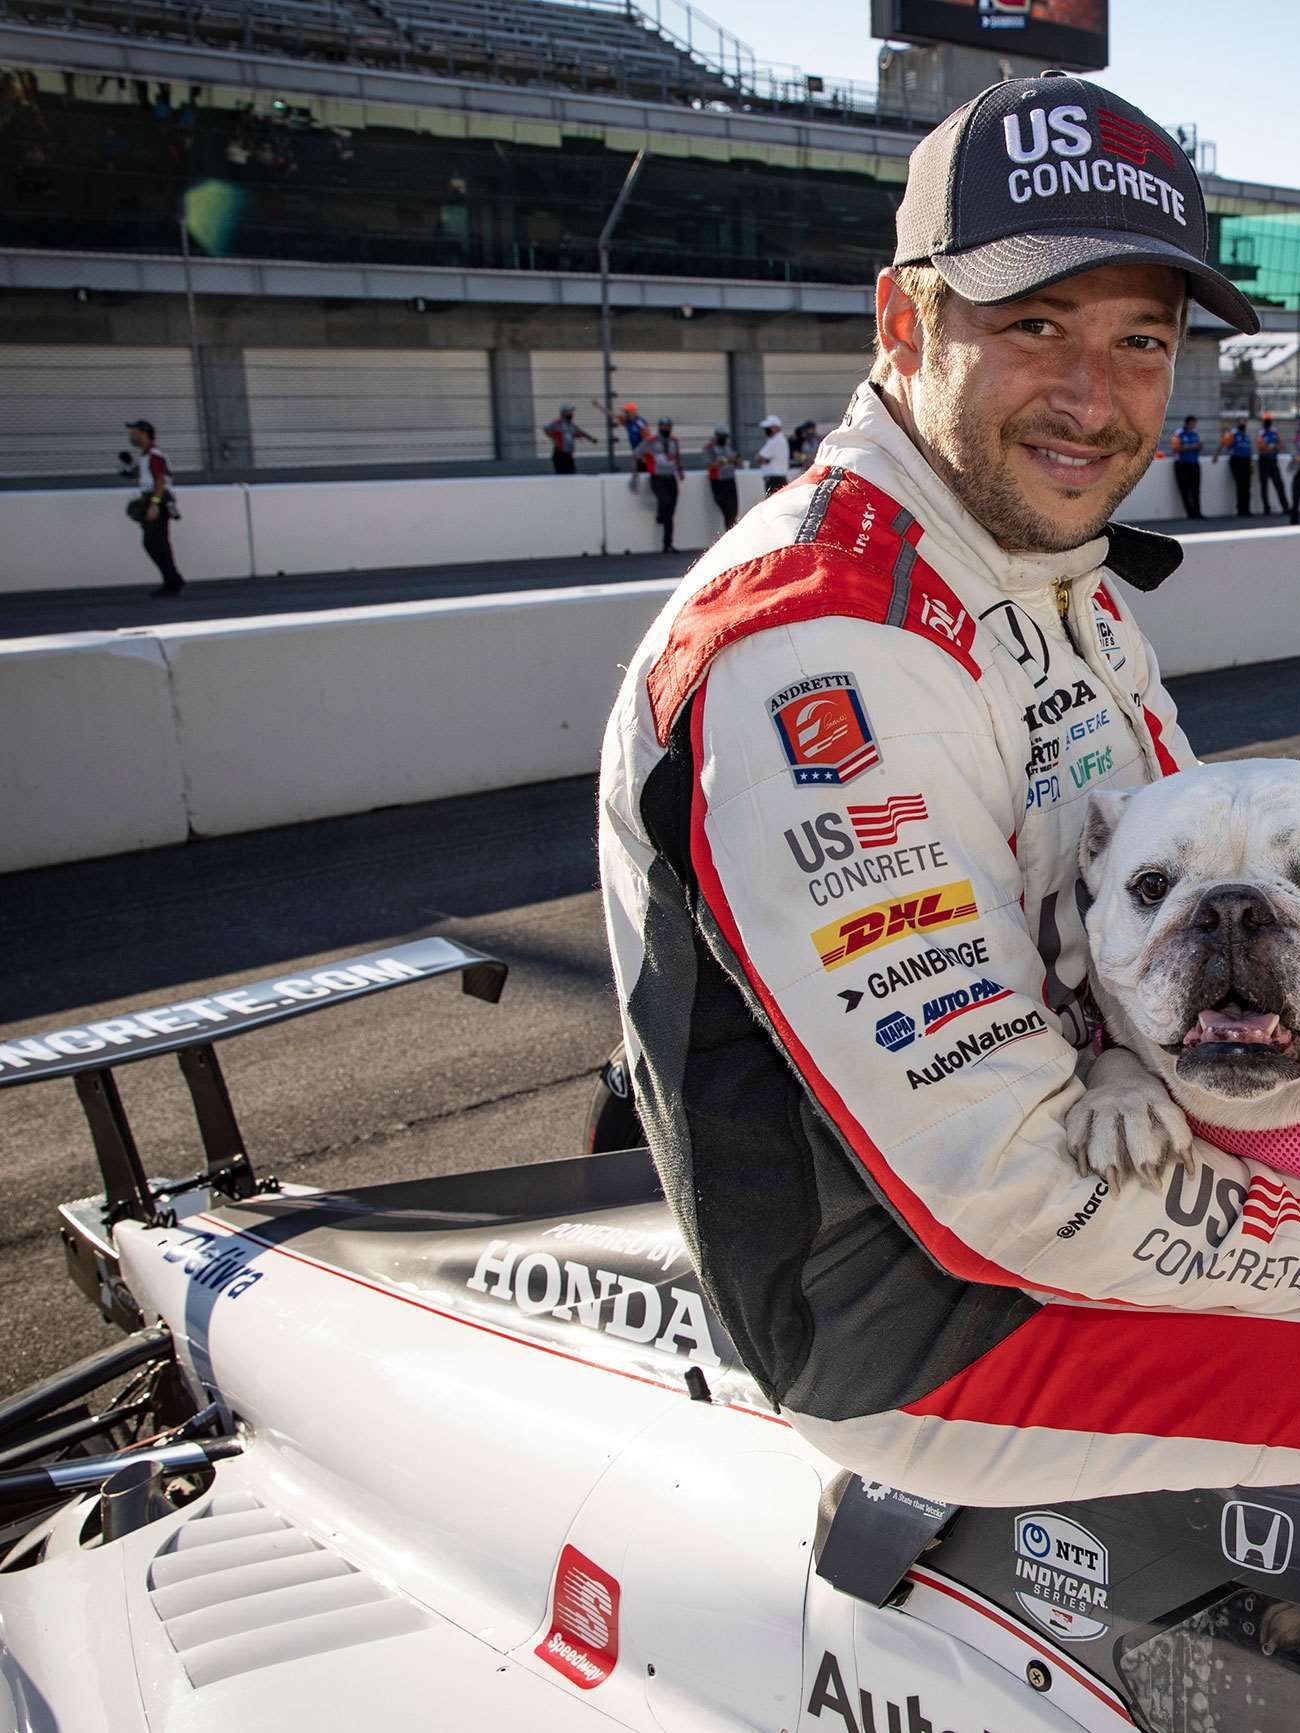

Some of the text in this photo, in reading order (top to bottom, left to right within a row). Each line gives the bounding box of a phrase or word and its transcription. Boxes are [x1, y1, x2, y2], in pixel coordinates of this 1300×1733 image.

[1003, 105, 1092, 164] US
[1008, 159, 1186, 226] CONCRETE
[770, 675, 853, 713] ANDRETTI
[784, 812, 854, 873] US
[808, 842, 948, 907] CONCRETE
[839, 893, 955, 956] DHL
[0, 957, 424, 1071] NCRETE.COM
[879, 1017, 913, 1044] NAPA
[922, 977, 1005, 1026] AUTO PA
[906, 1010, 1046, 1090] AutoNation
[1056, 1178, 1110, 1239] @Marc
[1165, 1162, 1249, 1248] US
[466, 1240, 721, 1366] HONDA
[1015, 1558, 1108, 1609] INDYCAR
[1056, 1539, 1098, 1570] NTT
[1033, 1584, 1086, 1612] SERIES
[548, 1632, 604, 1681] Speedway
